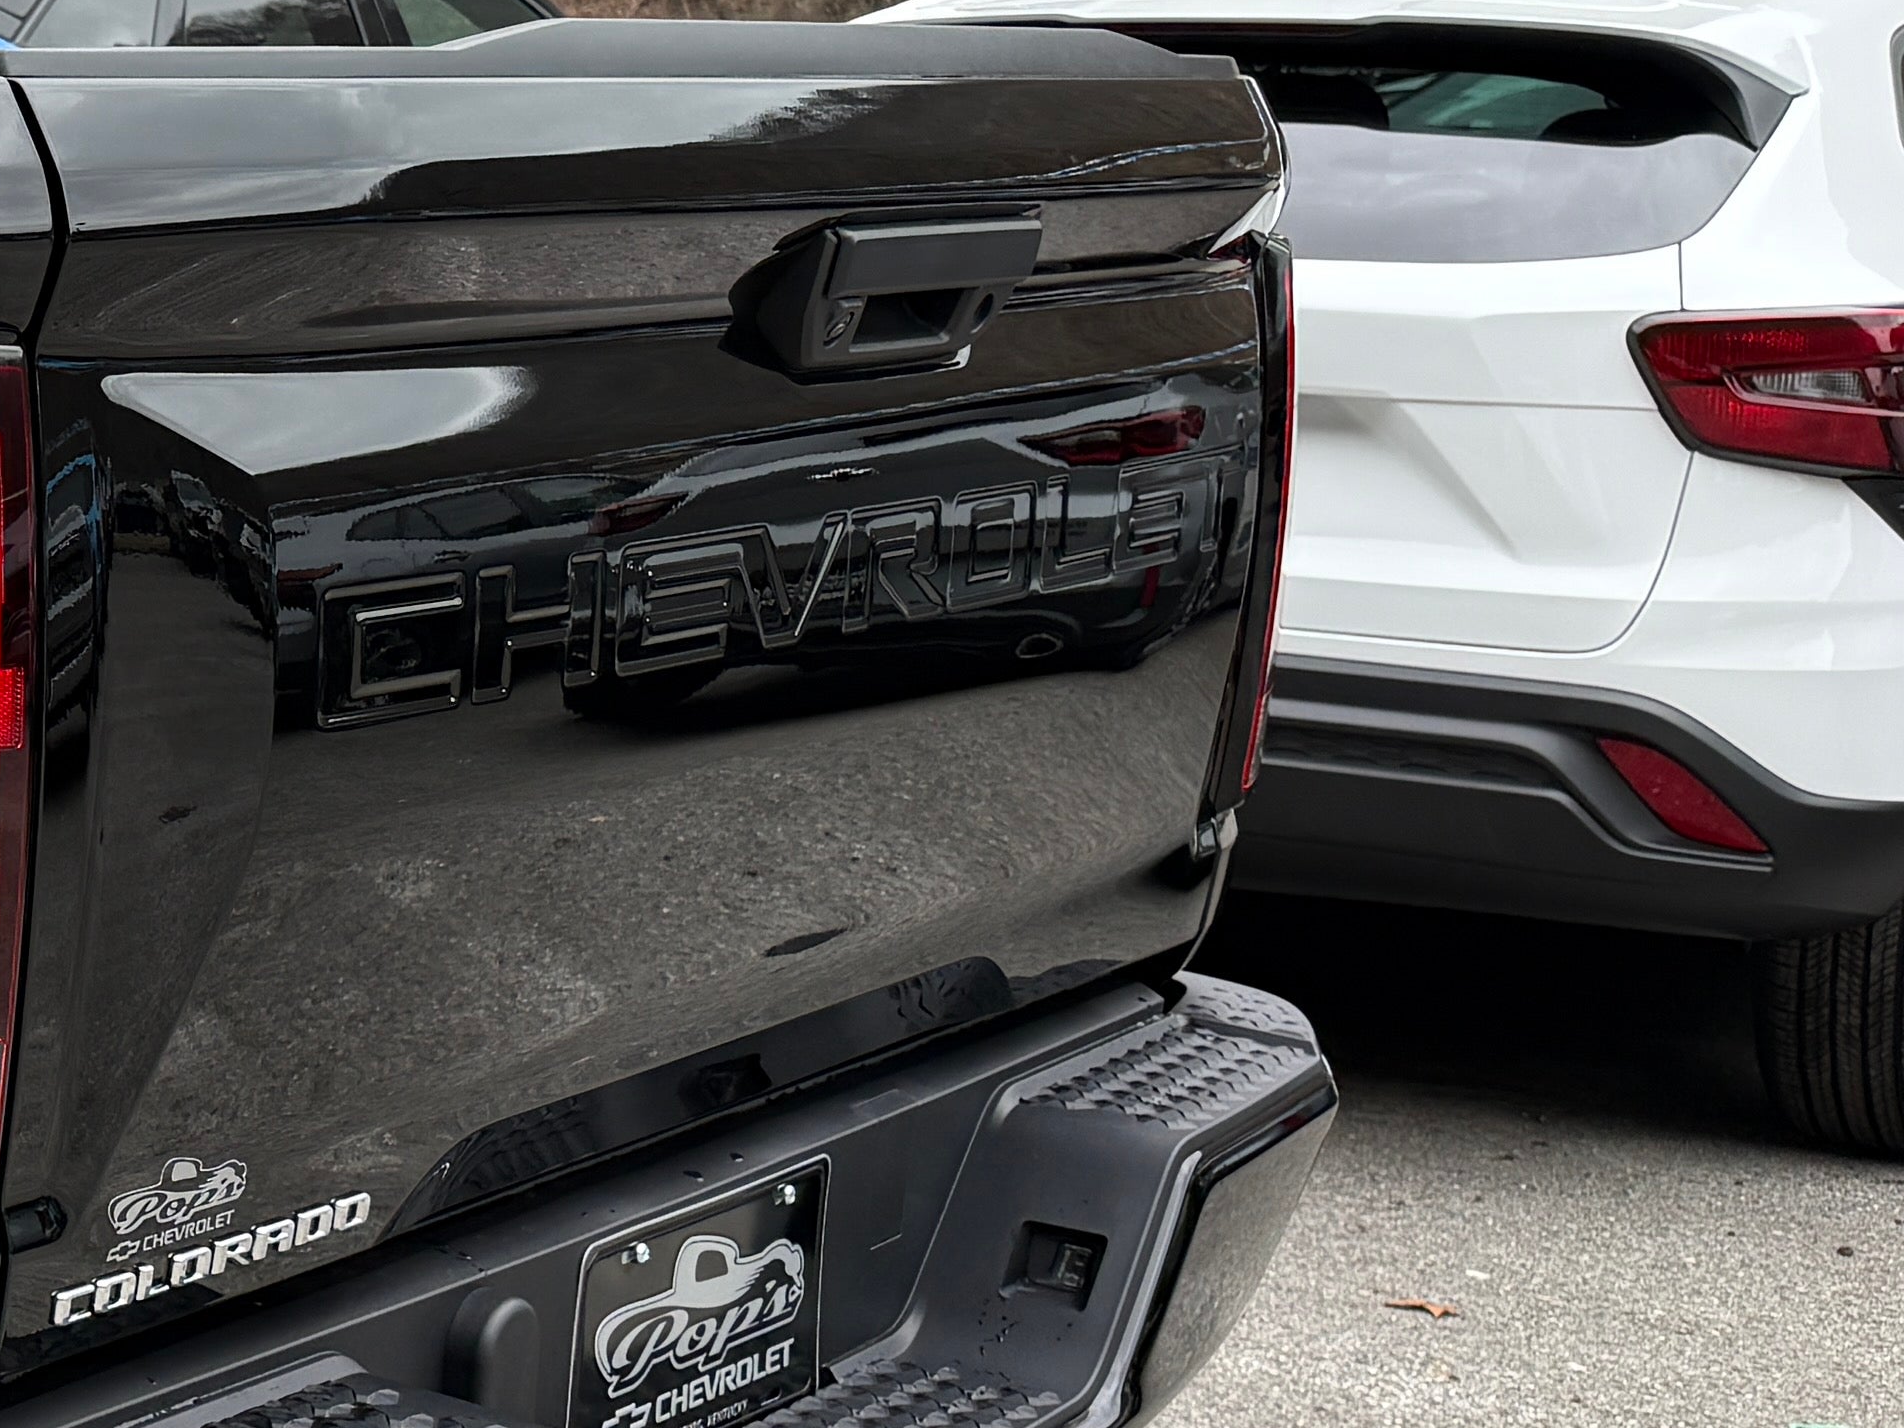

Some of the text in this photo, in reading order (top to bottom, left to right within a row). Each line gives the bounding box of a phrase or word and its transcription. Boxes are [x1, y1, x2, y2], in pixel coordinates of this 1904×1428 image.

[316, 444, 1244, 731] CHEVROLET
[49, 1192, 372, 1326] COLORADO
[142, 1209, 236, 1252] CHEVROLET
[609, 1278, 803, 1386] Pop's
[655, 1337, 795, 1424] CHEVROLET
